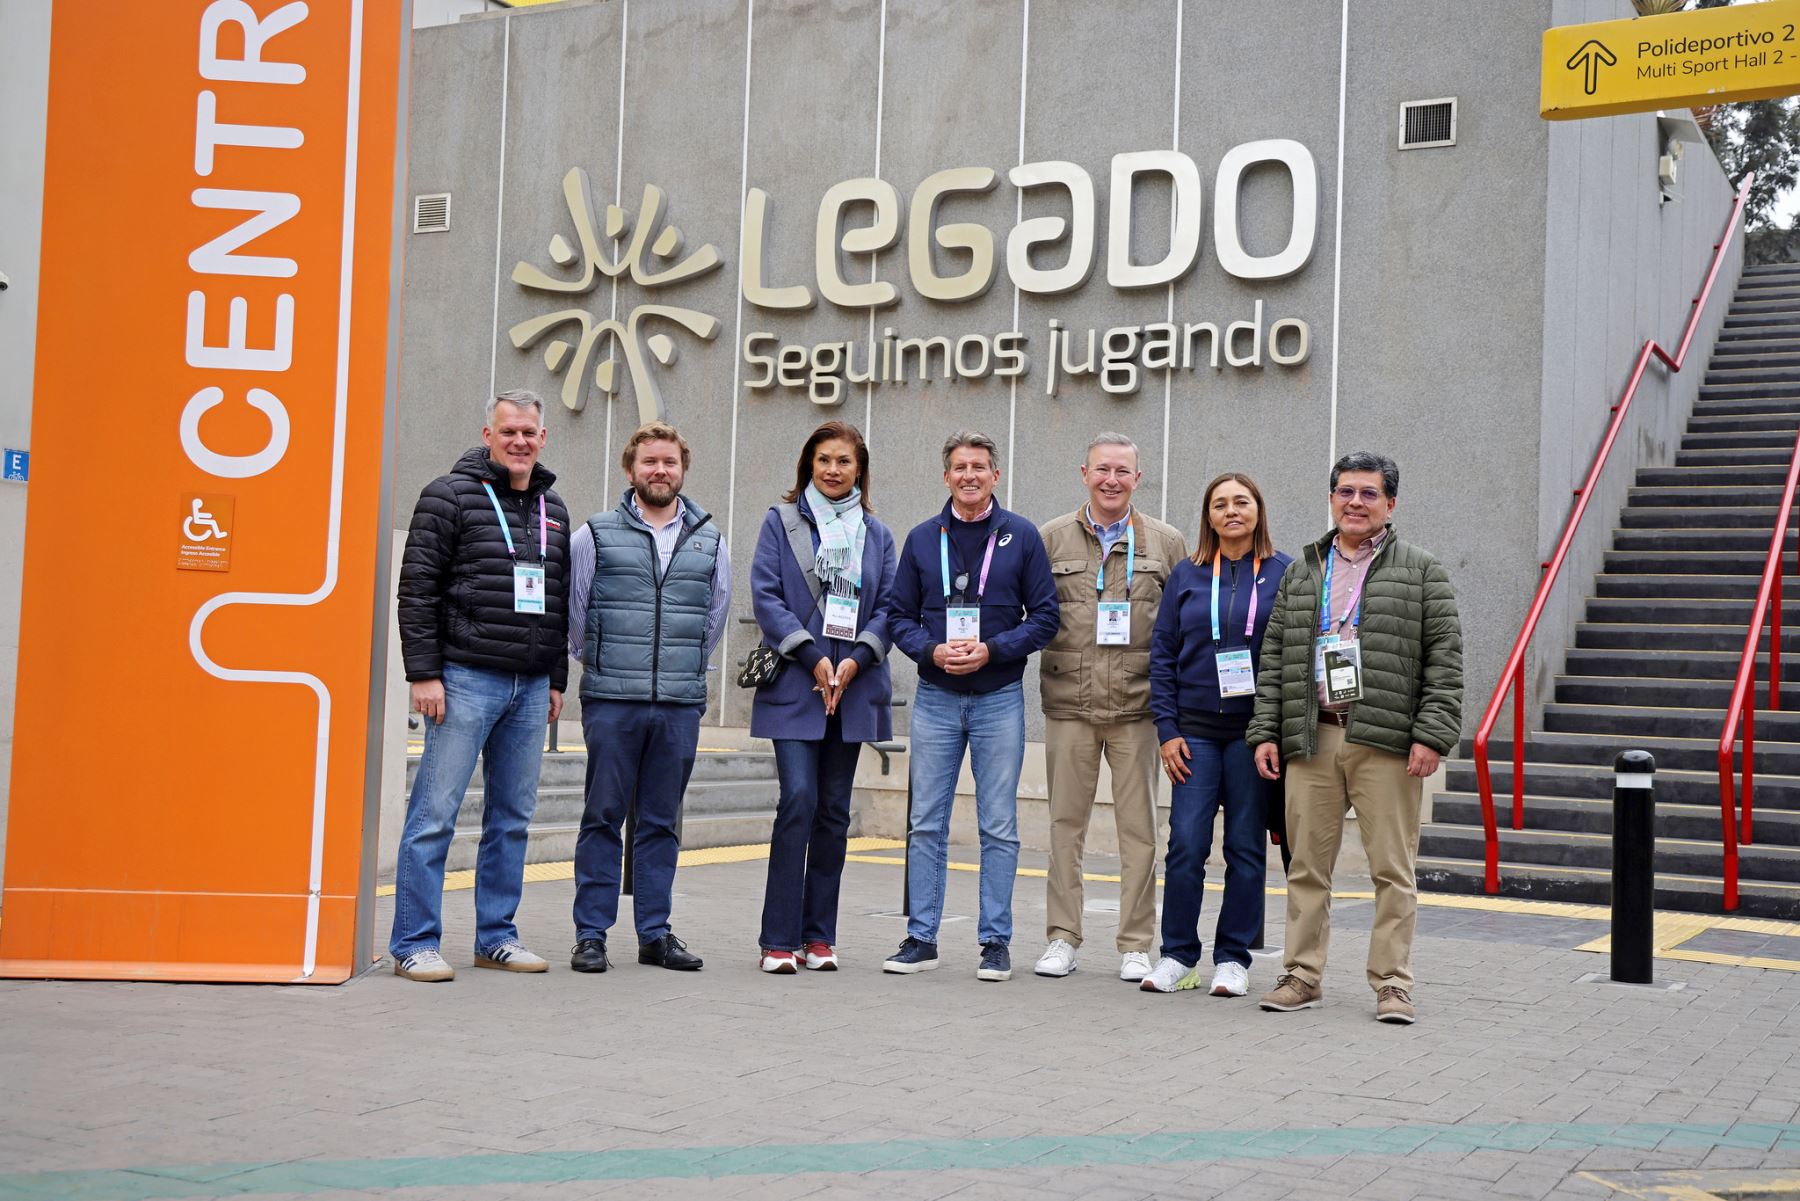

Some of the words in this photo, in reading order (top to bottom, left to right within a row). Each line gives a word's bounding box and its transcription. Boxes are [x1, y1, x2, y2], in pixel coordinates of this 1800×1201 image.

[1637, 29, 1774, 59] Polideportivo
[1782, 24, 1795, 42] 2
[1637, 62, 1676, 80] Multi
[1682, 57, 1729, 77] Sport
[1734, 51, 1766, 69] Hall
[1773, 49, 1783, 65] 2
[180, 0, 310, 479] CENTR
[743, 326, 1028, 405] Seguimos
[1047, 299, 1311, 398] jugando
[12, 454, 21, 470] E
